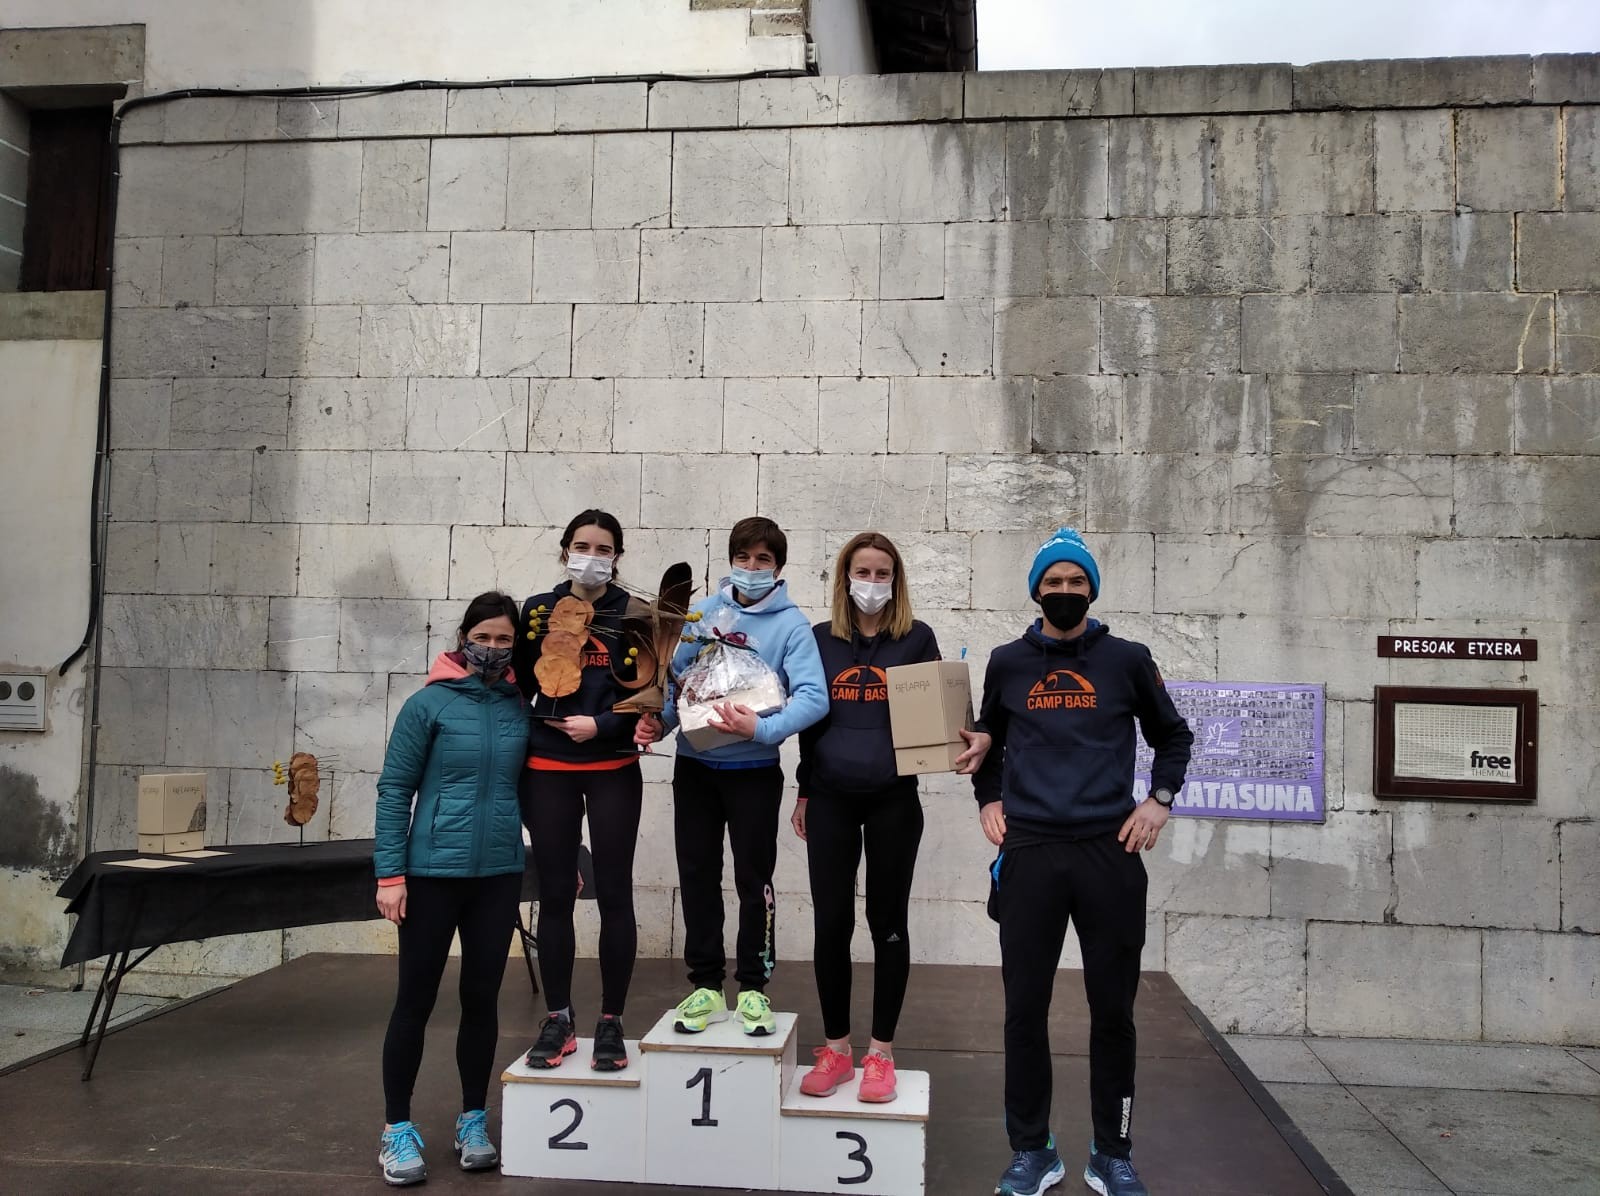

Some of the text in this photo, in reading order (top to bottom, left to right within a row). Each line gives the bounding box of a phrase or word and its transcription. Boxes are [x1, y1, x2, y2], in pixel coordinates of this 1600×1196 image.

[1394, 639, 1522, 656] PRESOAK ETXERA
[864, 687, 888, 702] BAS
[1027, 695, 1097, 711] CAMP BASE
[1470, 750, 1512, 770] free
[1132, 779, 1315, 813] AATASUNA
[686, 1067, 719, 1127] 1
[547, 1098, 588, 1150] 2
[836, 1131, 873, 1185] 3
